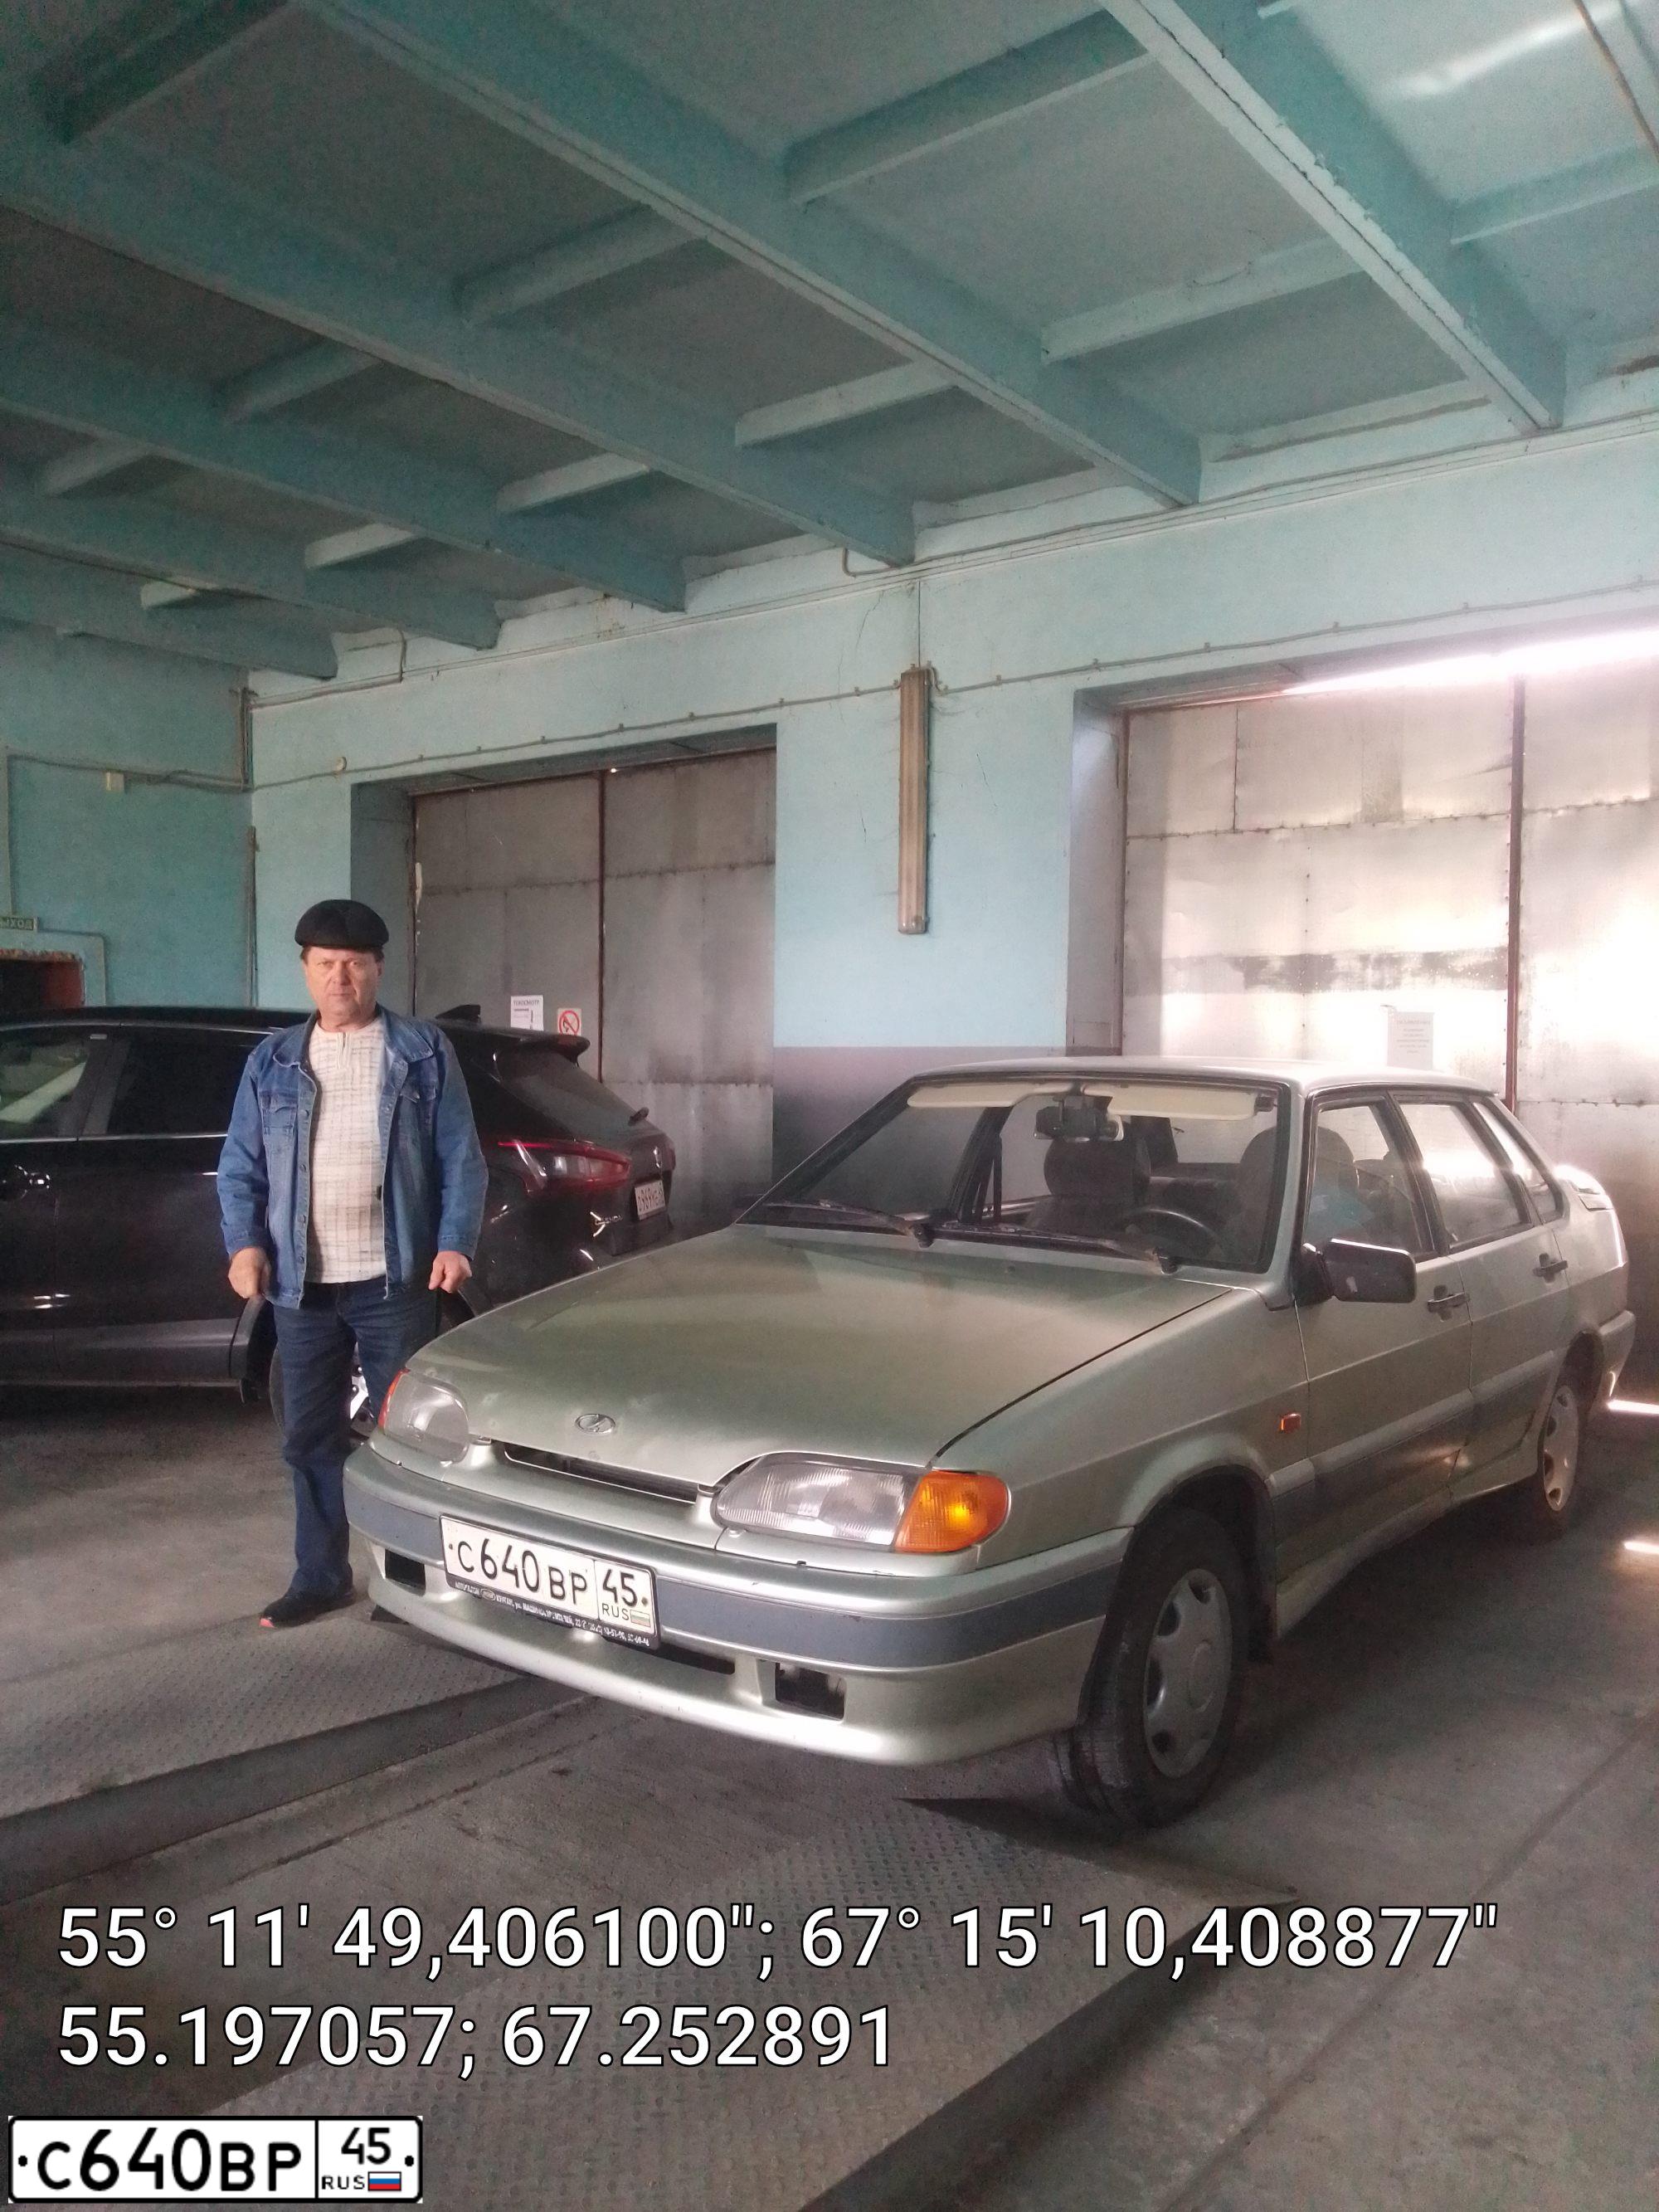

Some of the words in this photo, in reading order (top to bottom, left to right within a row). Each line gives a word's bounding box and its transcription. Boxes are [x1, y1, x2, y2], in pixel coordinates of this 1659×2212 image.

[457, 1537, 588, 1605] С640ВР
[602, 1568, 639, 1607] 45
[601, 1603, 630, 1621] RUS
